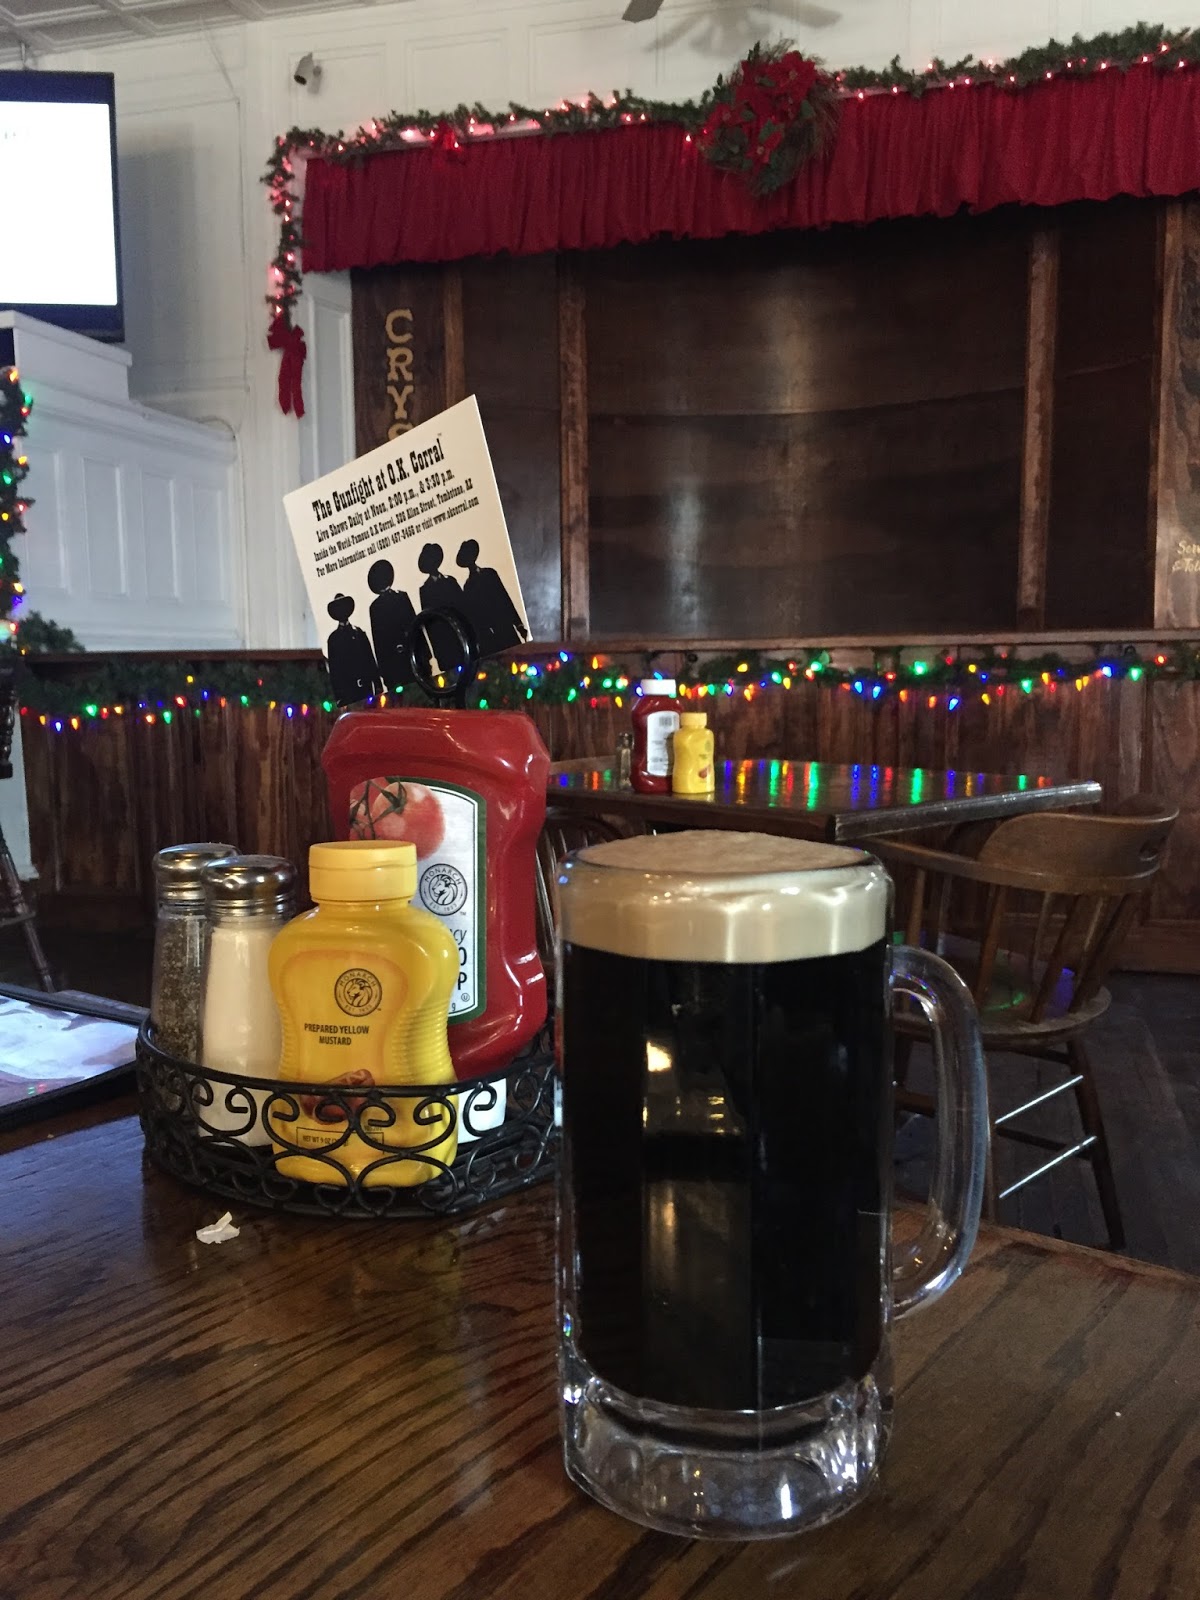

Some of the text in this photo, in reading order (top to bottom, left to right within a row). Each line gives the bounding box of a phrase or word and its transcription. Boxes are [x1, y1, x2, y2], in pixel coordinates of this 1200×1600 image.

[312, 438, 444, 521] The Gunfight at O.K. Corral
[316, 529, 330, 542] Live
[329, 520, 348, 540] Shows
[348, 512, 364, 528] Daily
[364, 509, 371, 521] at
[370, 502, 388, 518] Noon,
[388, 492, 403, 509] 2:00
[419, 480, 426, 494] &
[441, 469, 455, 486] p.m.
[314, 548, 329, 561] Inside
[328, 544, 337, 554] the
[336, 530, 370, 552] World-Famous
[316, 567, 325, 578] For
[325, 562, 338, 574] More
[367, 543, 376, 556] call
[415, 524, 422, 533] or
[422, 516, 434, 530] visit
[425, 867, 462, 885] MONARCH
[340, 972, 376, 987] MONARCH
[304, 1023, 370, 1034] PREPARED YELLOW
[319, 1036, 352, 1046] MUSTARD
